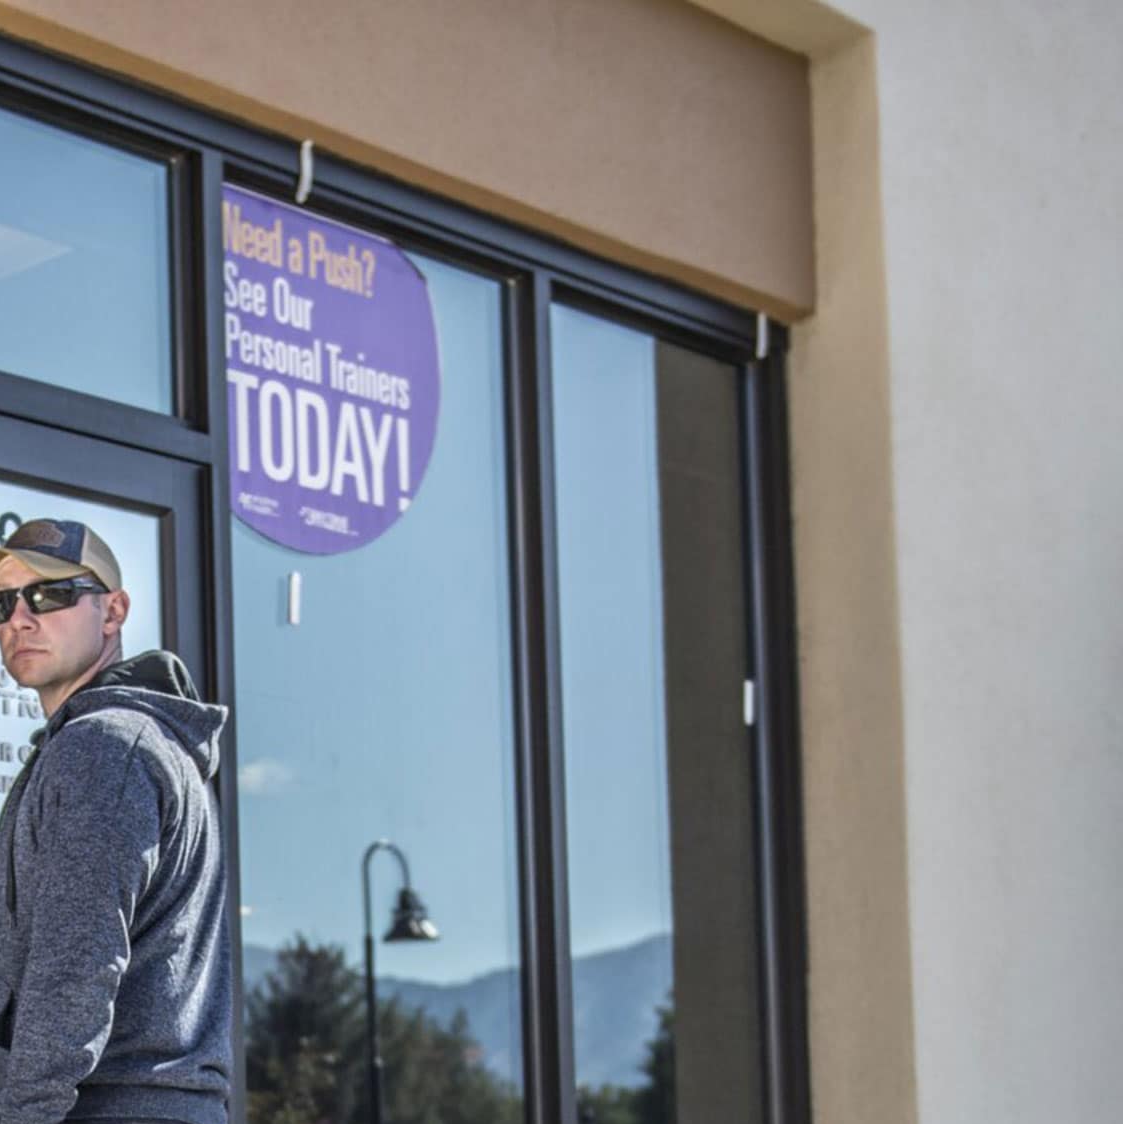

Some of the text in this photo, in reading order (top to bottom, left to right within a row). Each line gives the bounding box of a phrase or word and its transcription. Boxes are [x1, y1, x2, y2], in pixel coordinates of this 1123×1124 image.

[222, 201, 375, 298] Need a Push?
[224, 261, 314, 331] See Our
[225, 312, 411, 410] Personal Trainers
[227, 368, 411, 512] TODAY!
